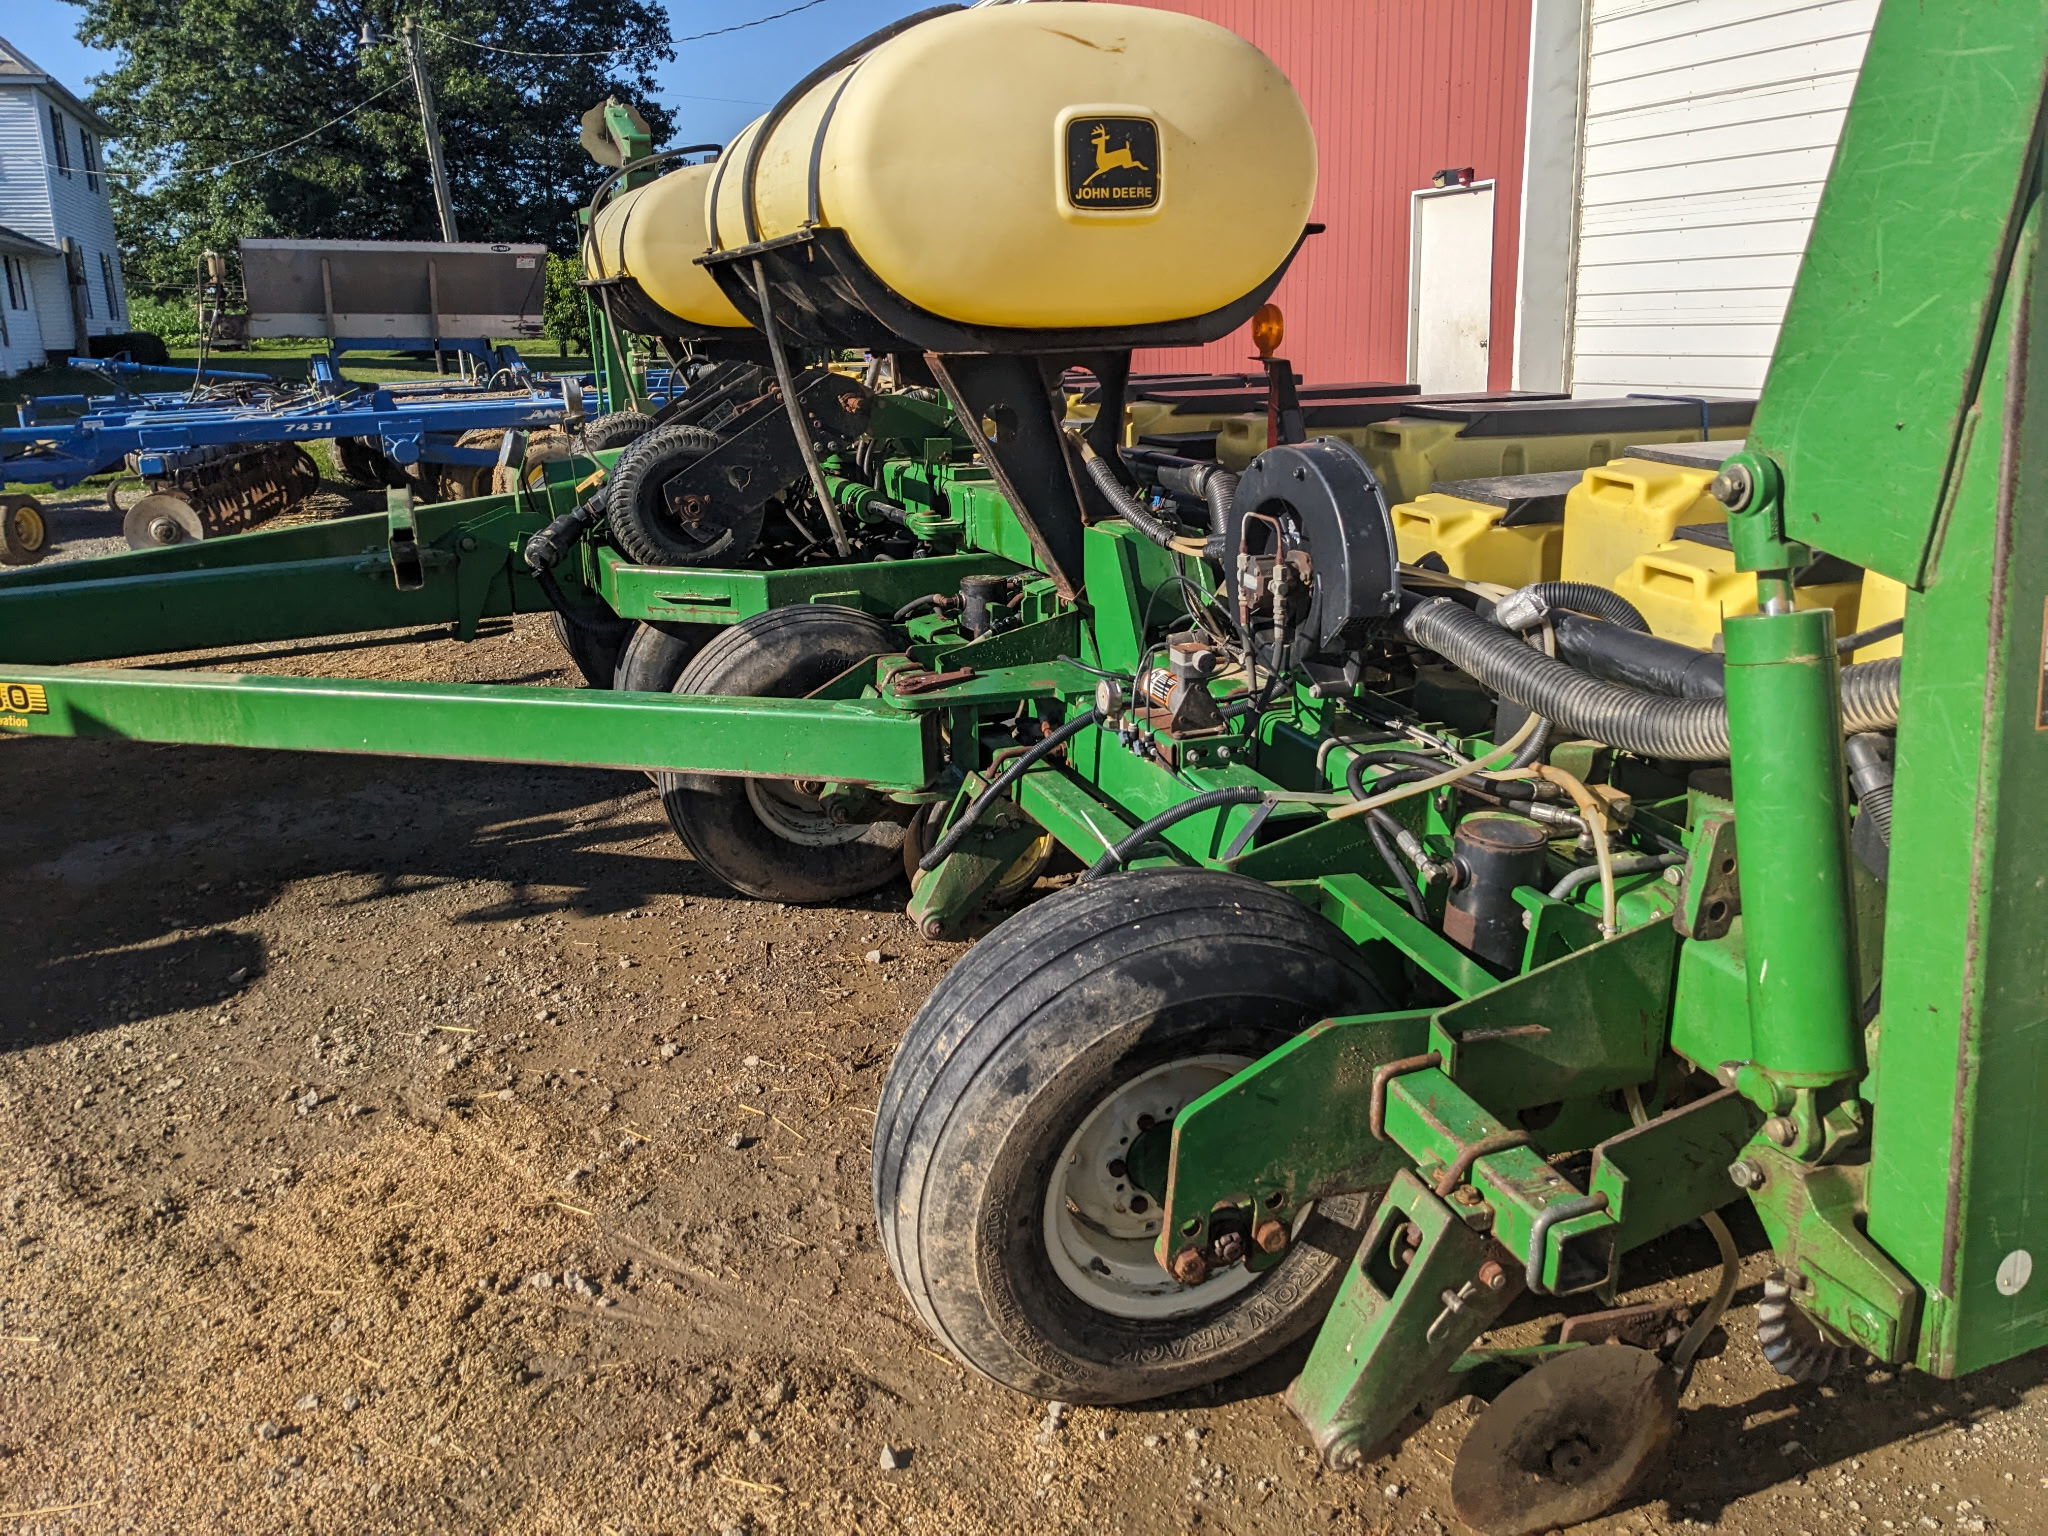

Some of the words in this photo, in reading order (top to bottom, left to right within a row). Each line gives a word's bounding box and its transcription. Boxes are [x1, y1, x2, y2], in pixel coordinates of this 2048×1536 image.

[1075, 187, 1110, 199] JOHN
[1112, 186, 1152, 199] DEERE
[284, 422, 331, 432] 7431
[0, 684, 30, 710] 0
[1244, 1197, 1360, 1331] HRROW
